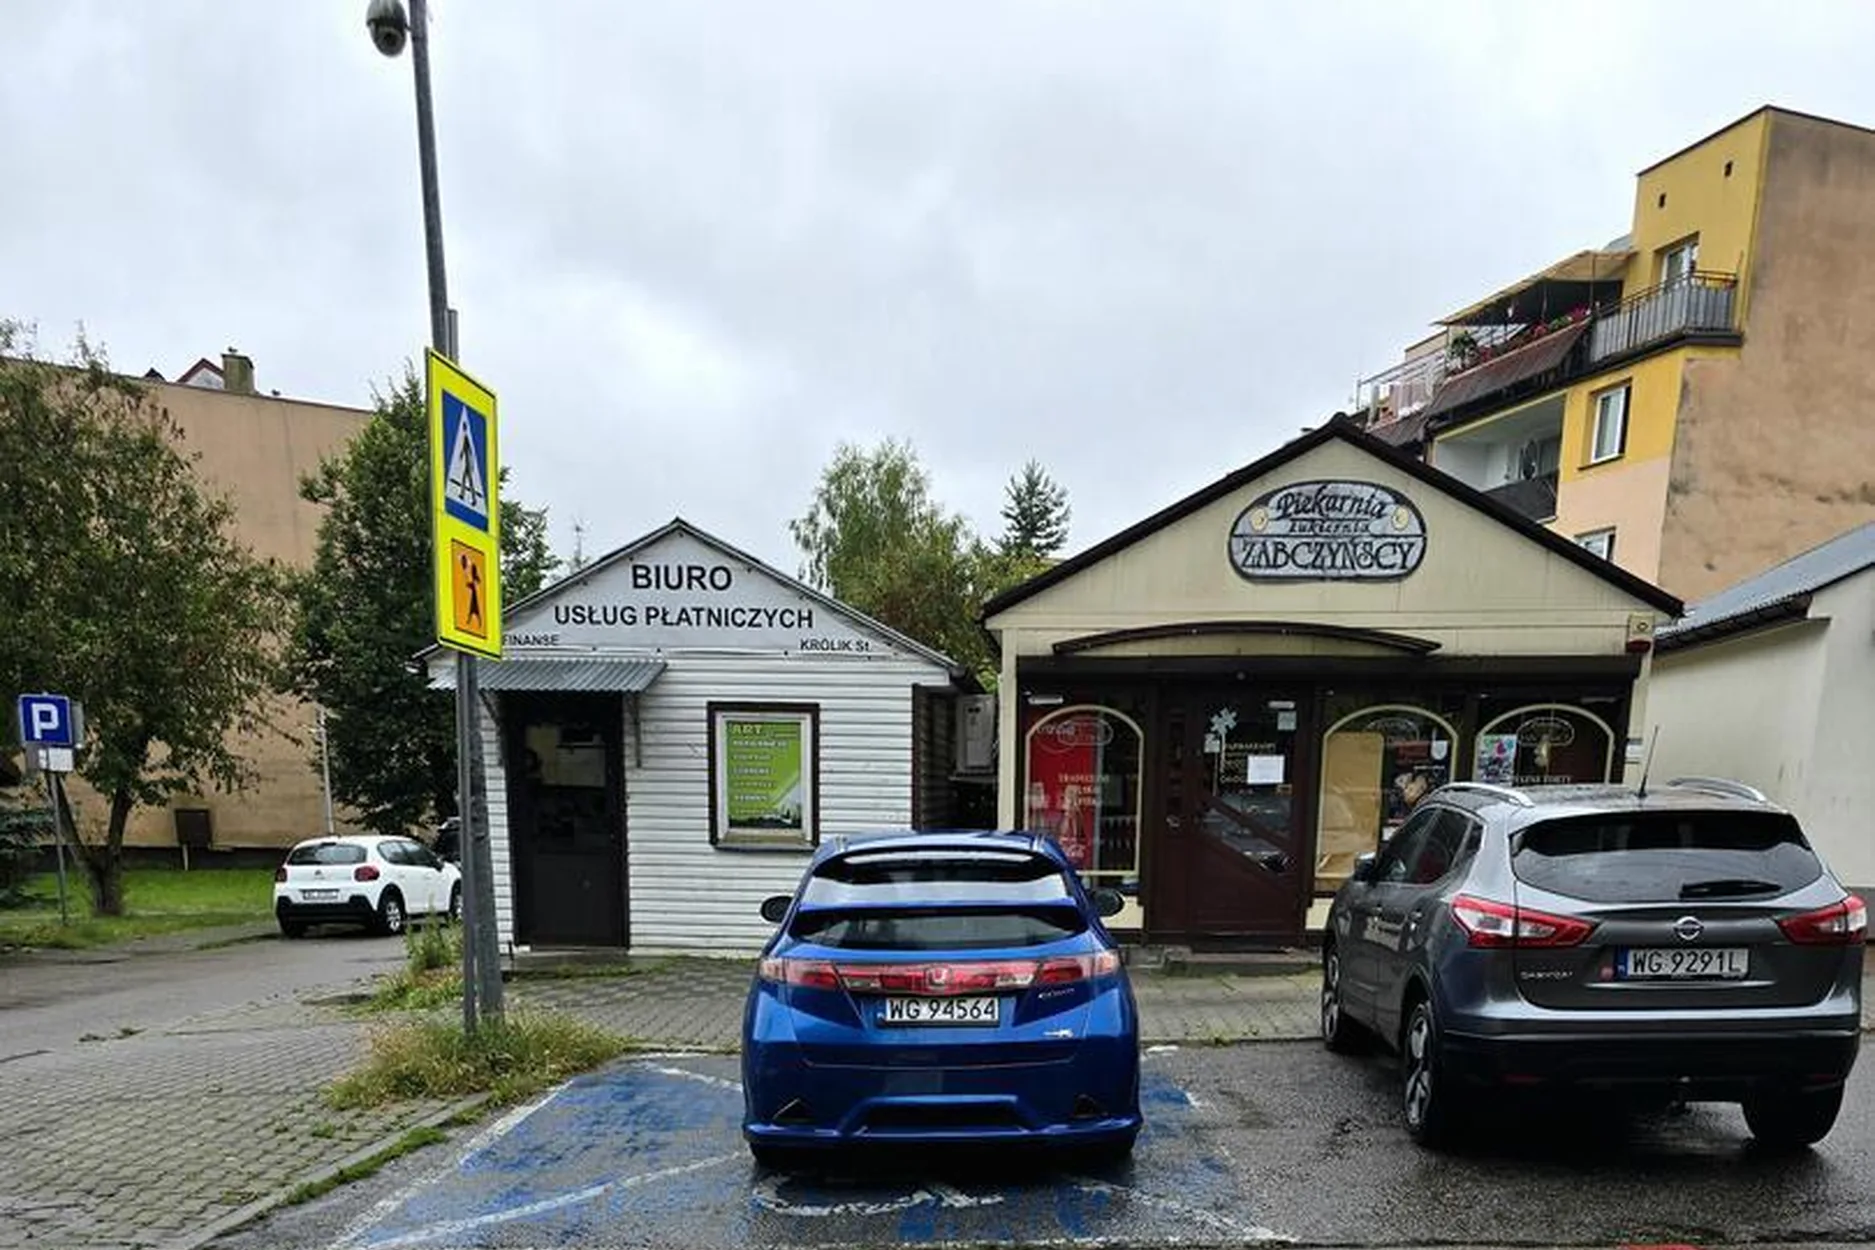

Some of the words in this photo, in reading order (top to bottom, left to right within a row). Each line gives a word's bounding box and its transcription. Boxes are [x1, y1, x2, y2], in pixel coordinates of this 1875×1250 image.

[1273, 485, 1387, 520] Piekarnia
[631, 564, 733, 591] BIURO
[554, 605, 638, 626] USŁUG
[645, 606, 814, 629] PŁATNICZYCH
[31, 702, 59, 740] P
[1632, 950, 1662, 973] WG
[1671, 950, 1742, 973] 9291L
[889, 999, 920, 1020] WG
[928, 999, 996, 1020] 94564
